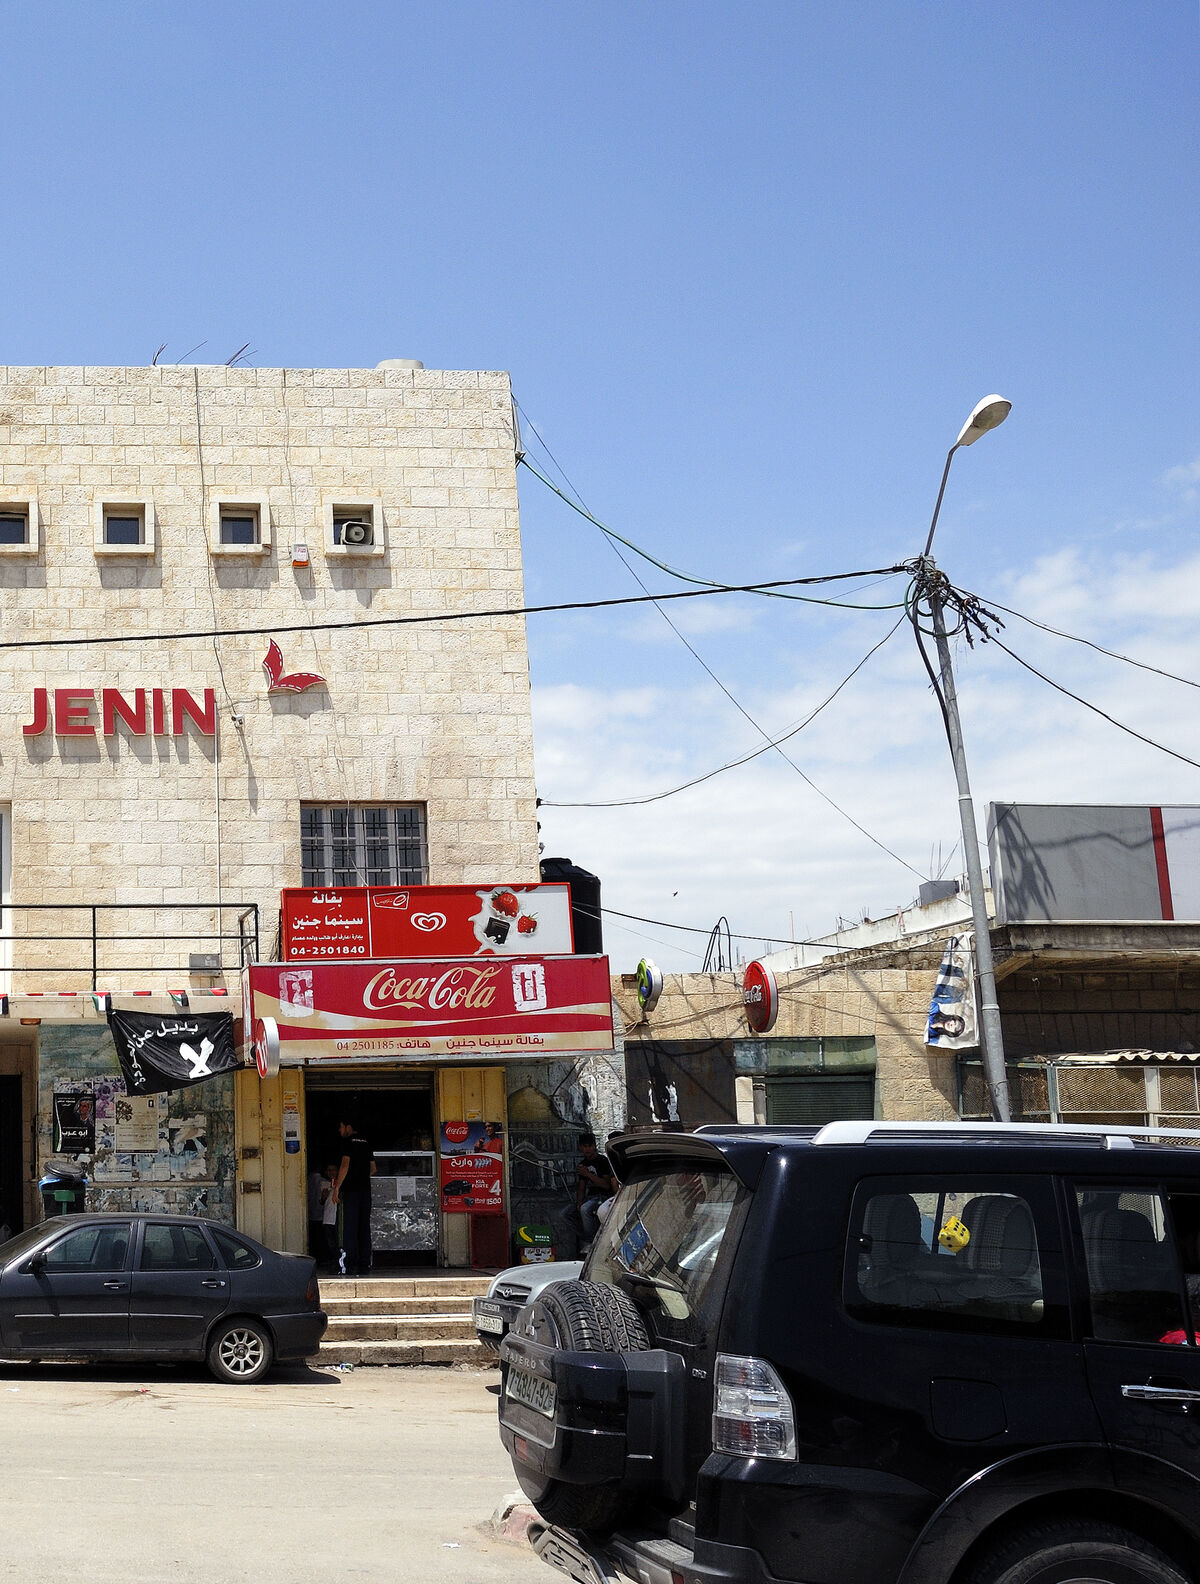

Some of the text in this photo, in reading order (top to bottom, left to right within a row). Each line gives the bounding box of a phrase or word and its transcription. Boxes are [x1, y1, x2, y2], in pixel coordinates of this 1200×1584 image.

[23, 688, 216, 736] JENIN
[311, 890, 343, 908] بقالة
[292, 914, 364, 930] سينما جنين
[290, 945, 365, 956] 04-2501840
[362, 966, 503, 1010] Coca-Cola
[156, 1021, 199, 1037] بديل
[133, 1029, 155, 1049] عن
[336, 1040, 395, 1051] 04 2501185
[445, 1038, 476, 1050] جنين
[478, 1037, 514, 1048] سينما
[515, 1034, 545, 1046] بقالة
[489, 1180, 502, 1196] 4
